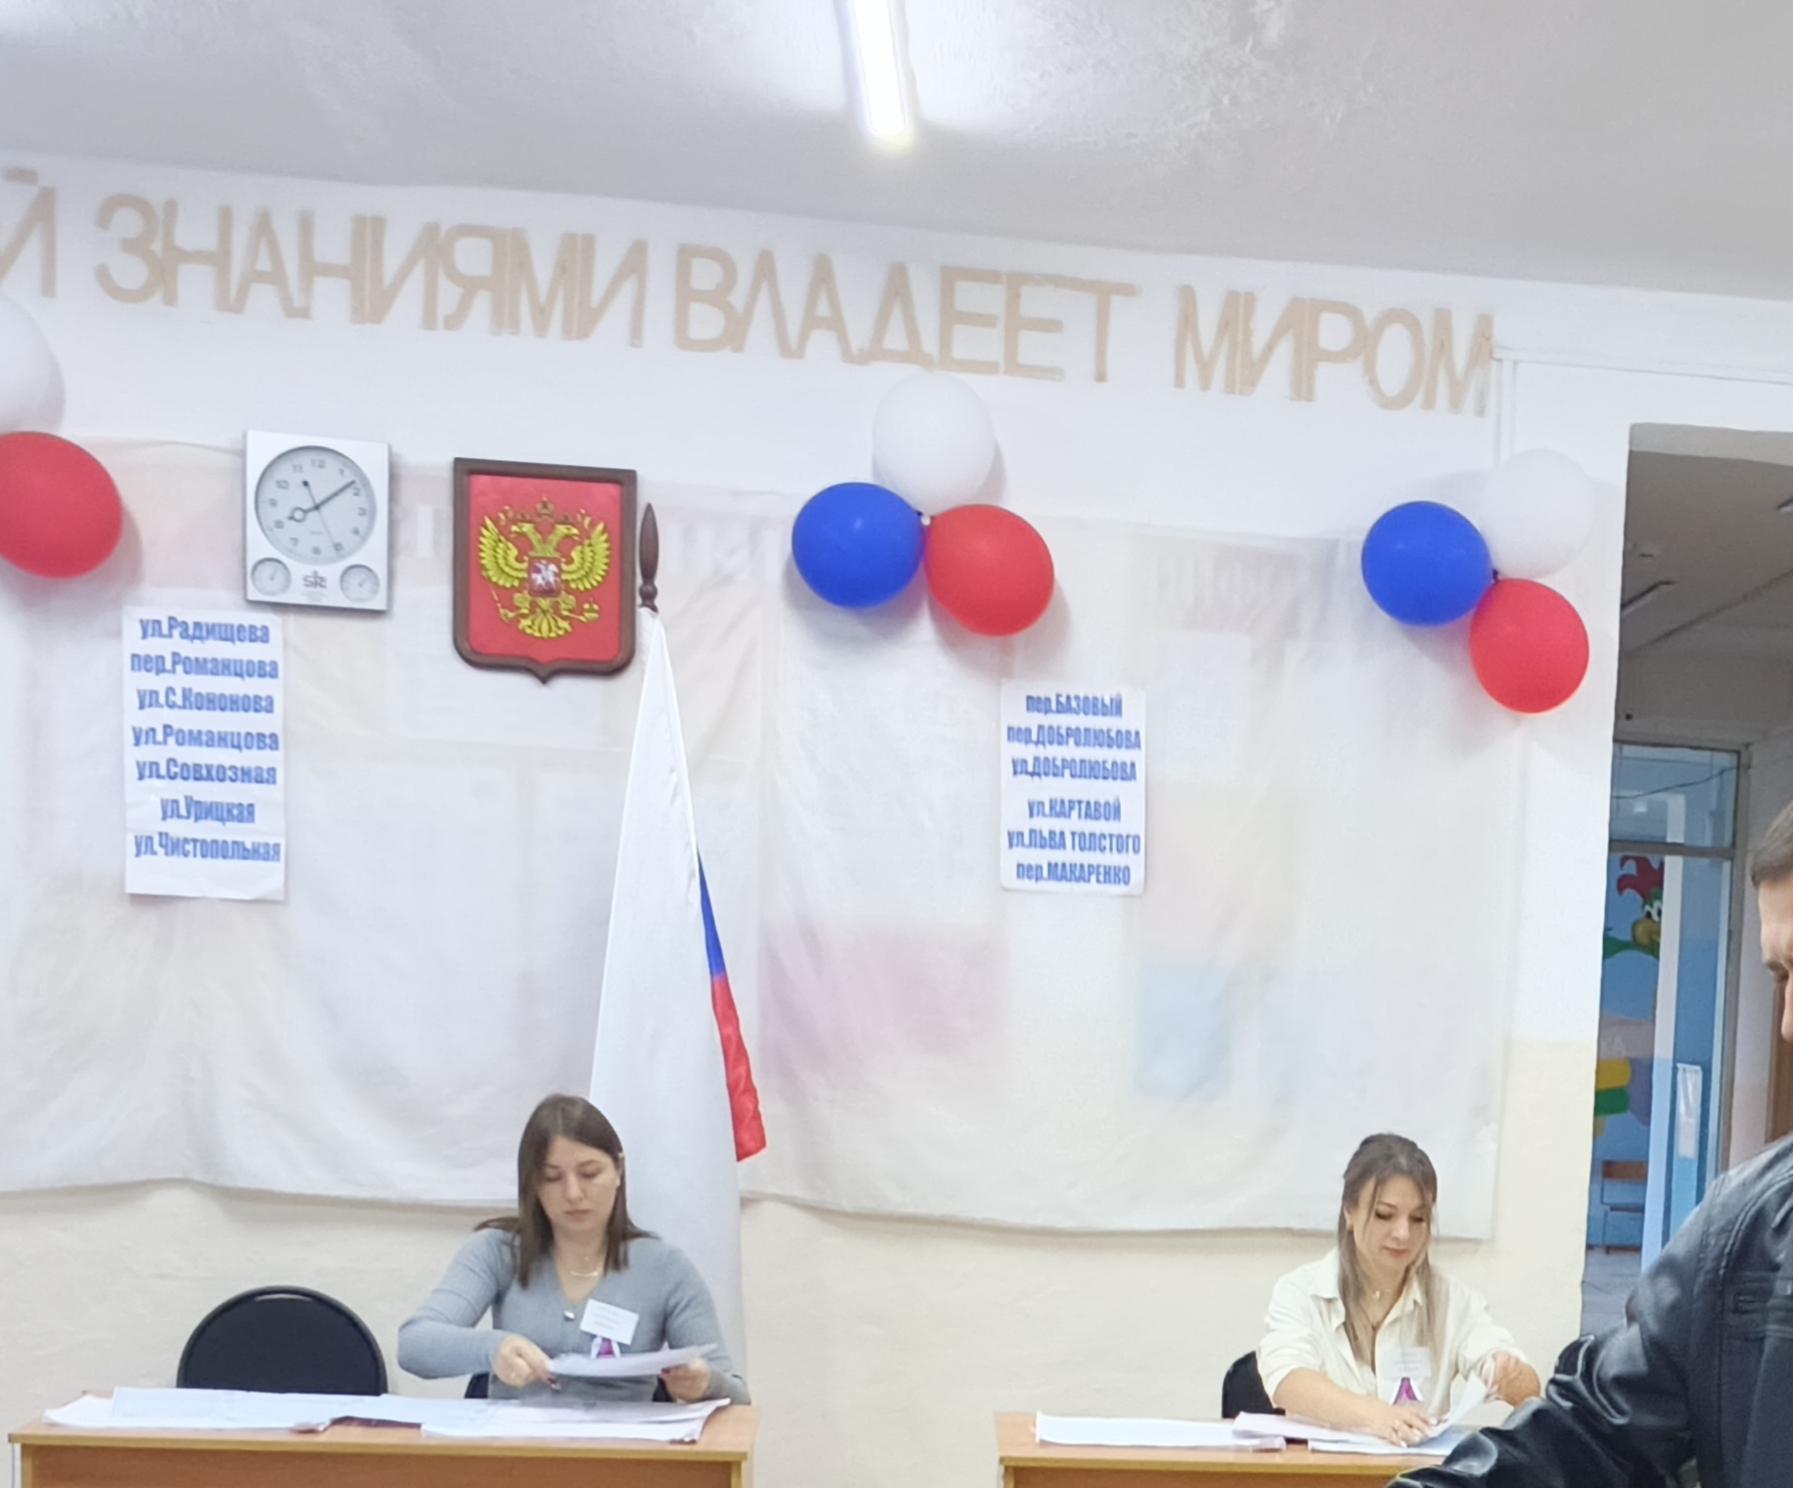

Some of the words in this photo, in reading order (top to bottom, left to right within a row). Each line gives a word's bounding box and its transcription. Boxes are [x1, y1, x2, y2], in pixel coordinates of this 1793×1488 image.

[93, 193, 648, 349] ЗНАНИЯМИ
[673, 243, 1138, 383] ВЛАДЕЕТ
[1175, 285, 1494, 417] МИРОМ
[139, 615, 270, 645] ул.Радищева
[131, 651, 279, 681] пер.Романцова
[1026, 692, 1122, 718] пер.БАЗОВЫЙ
[132, 724, 279, 753] ул.Романцова
[1007, 724, 1141, 750] пер.ДОБРОЛЮБОВА
[136, 757, 277, 785] ул.Совхозная
[1012, 756, 1136, 782] ул.ДОБРОЛЮБОВА
[160, 795, 255, 826] ул.Урицкая
[1028, 796, 1121, 822] ул.КАРТАВОЙ
[134, 832, 281, 862] ул.Чистопольная
[1007, 828, 1066, 851] ул.ЛЬВА
[1070, 830, 1141, 854] ТОЛСТОГО
[1016, 861, 1131, 886] пер.МАКАРЕНКО
